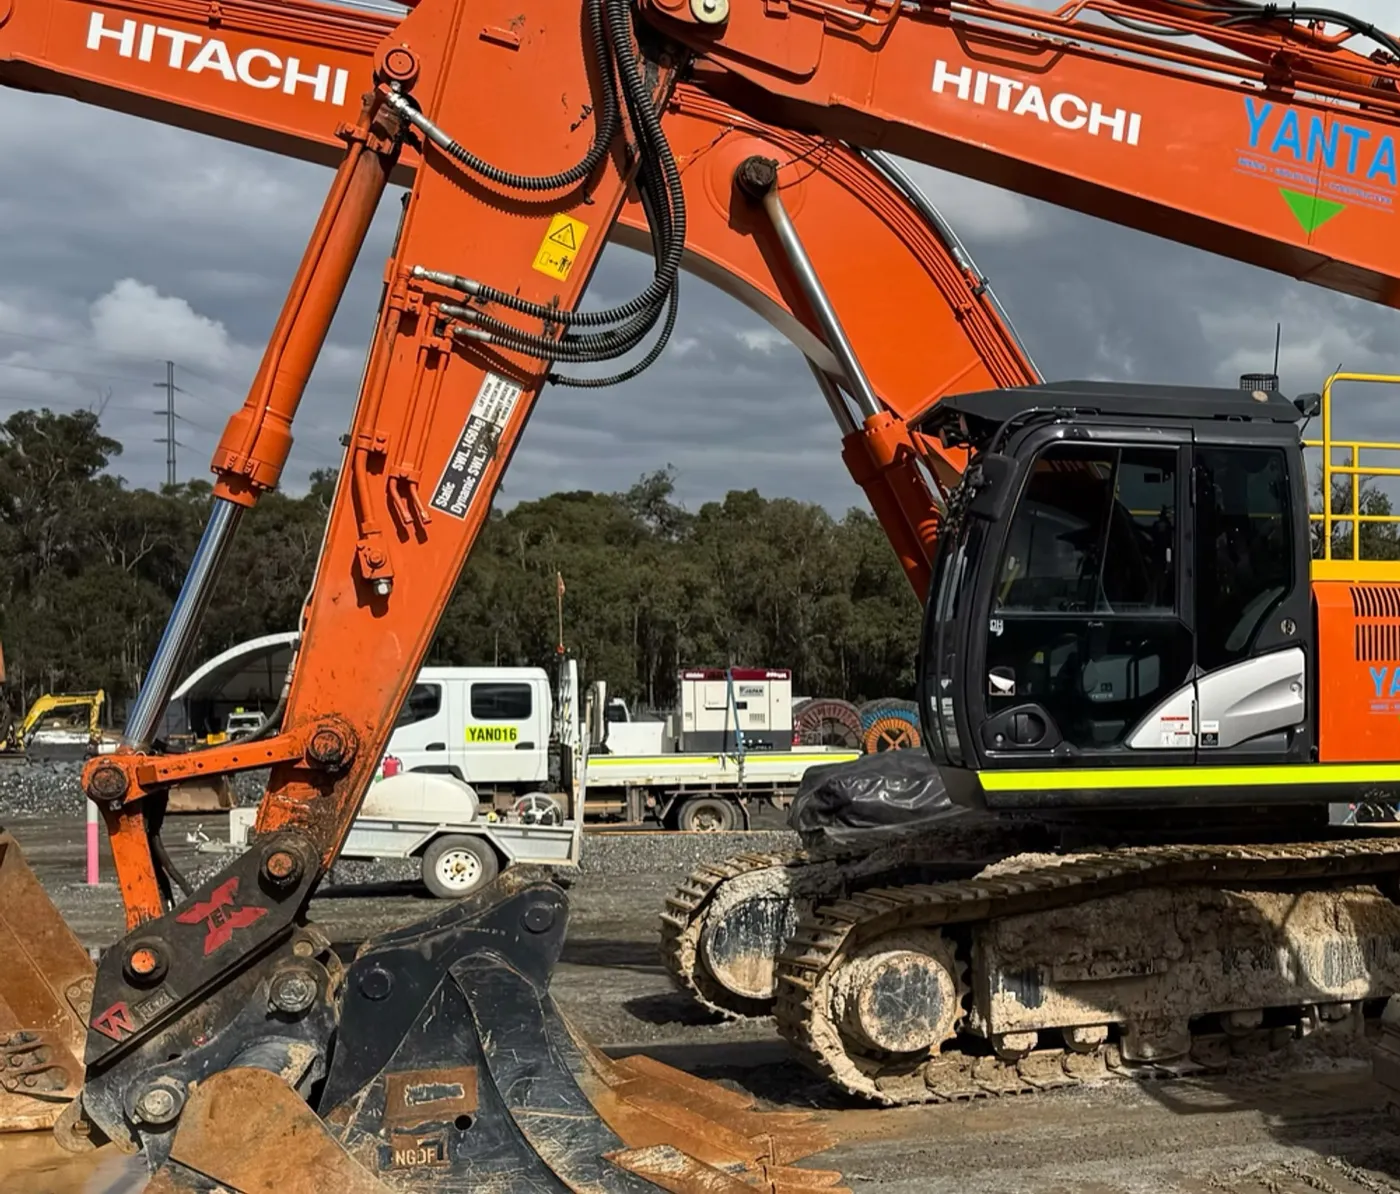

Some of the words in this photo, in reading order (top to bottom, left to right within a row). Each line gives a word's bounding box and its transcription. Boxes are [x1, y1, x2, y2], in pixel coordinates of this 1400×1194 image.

[86, 11, 349, 106] HITACHI
[932, 59, 1142, 146] HITACHI
[1244, 96, 1398, 186] YANTA
[435, 481, 456, 508] Static
[450, 476, 476, 514] Dynamic
[469, 727, 517, 741] YAN016
